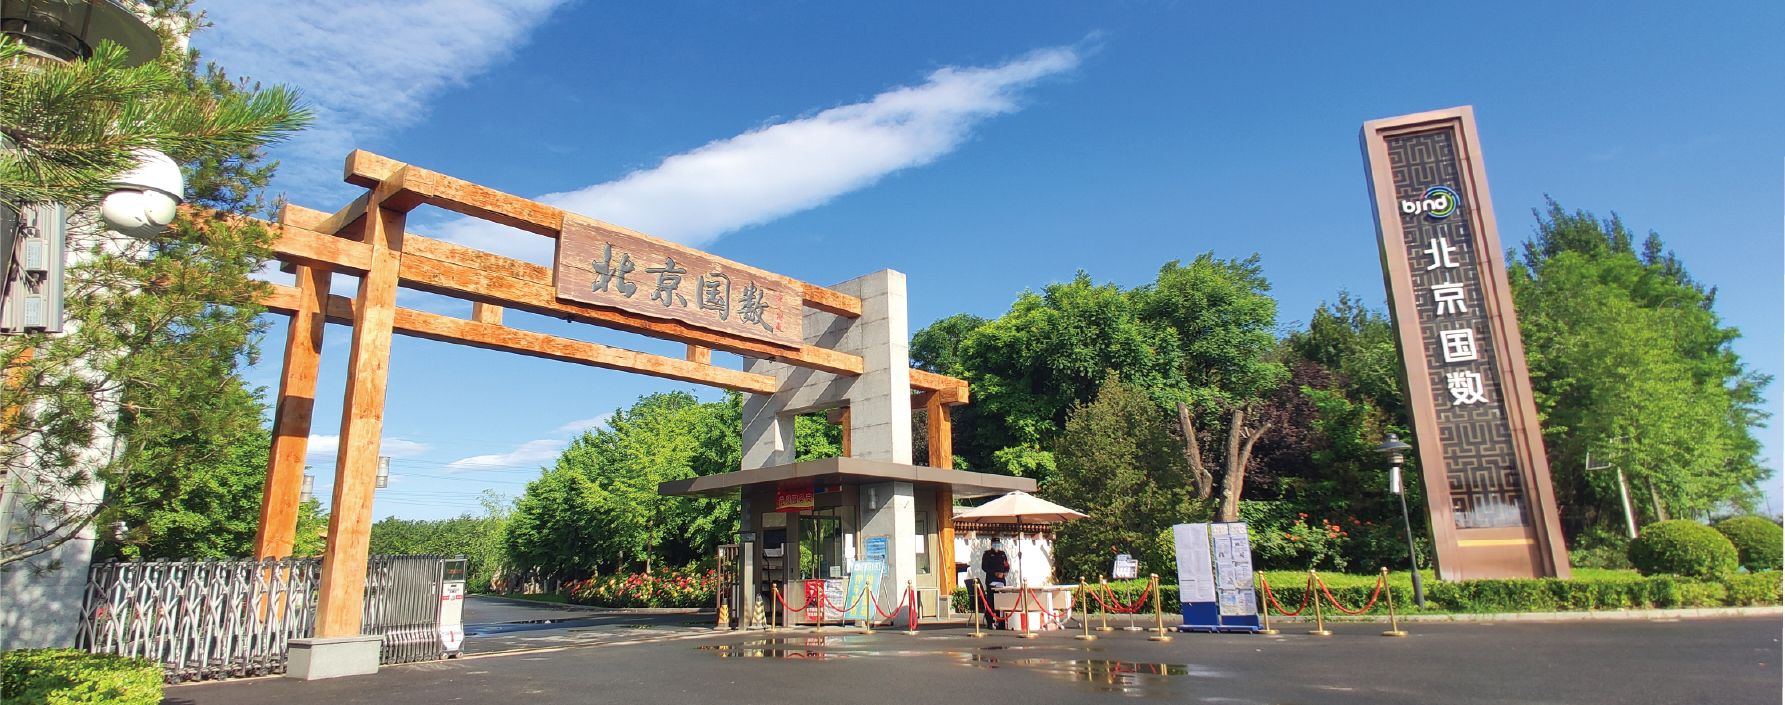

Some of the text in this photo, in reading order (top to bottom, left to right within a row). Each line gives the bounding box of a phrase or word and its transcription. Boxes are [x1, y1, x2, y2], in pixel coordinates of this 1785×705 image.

[1402, 195, 1448, 215] bjnd
[591, 241, 774, 333] 北京国数
[1424, 237, 1489, 406] 北京国数
